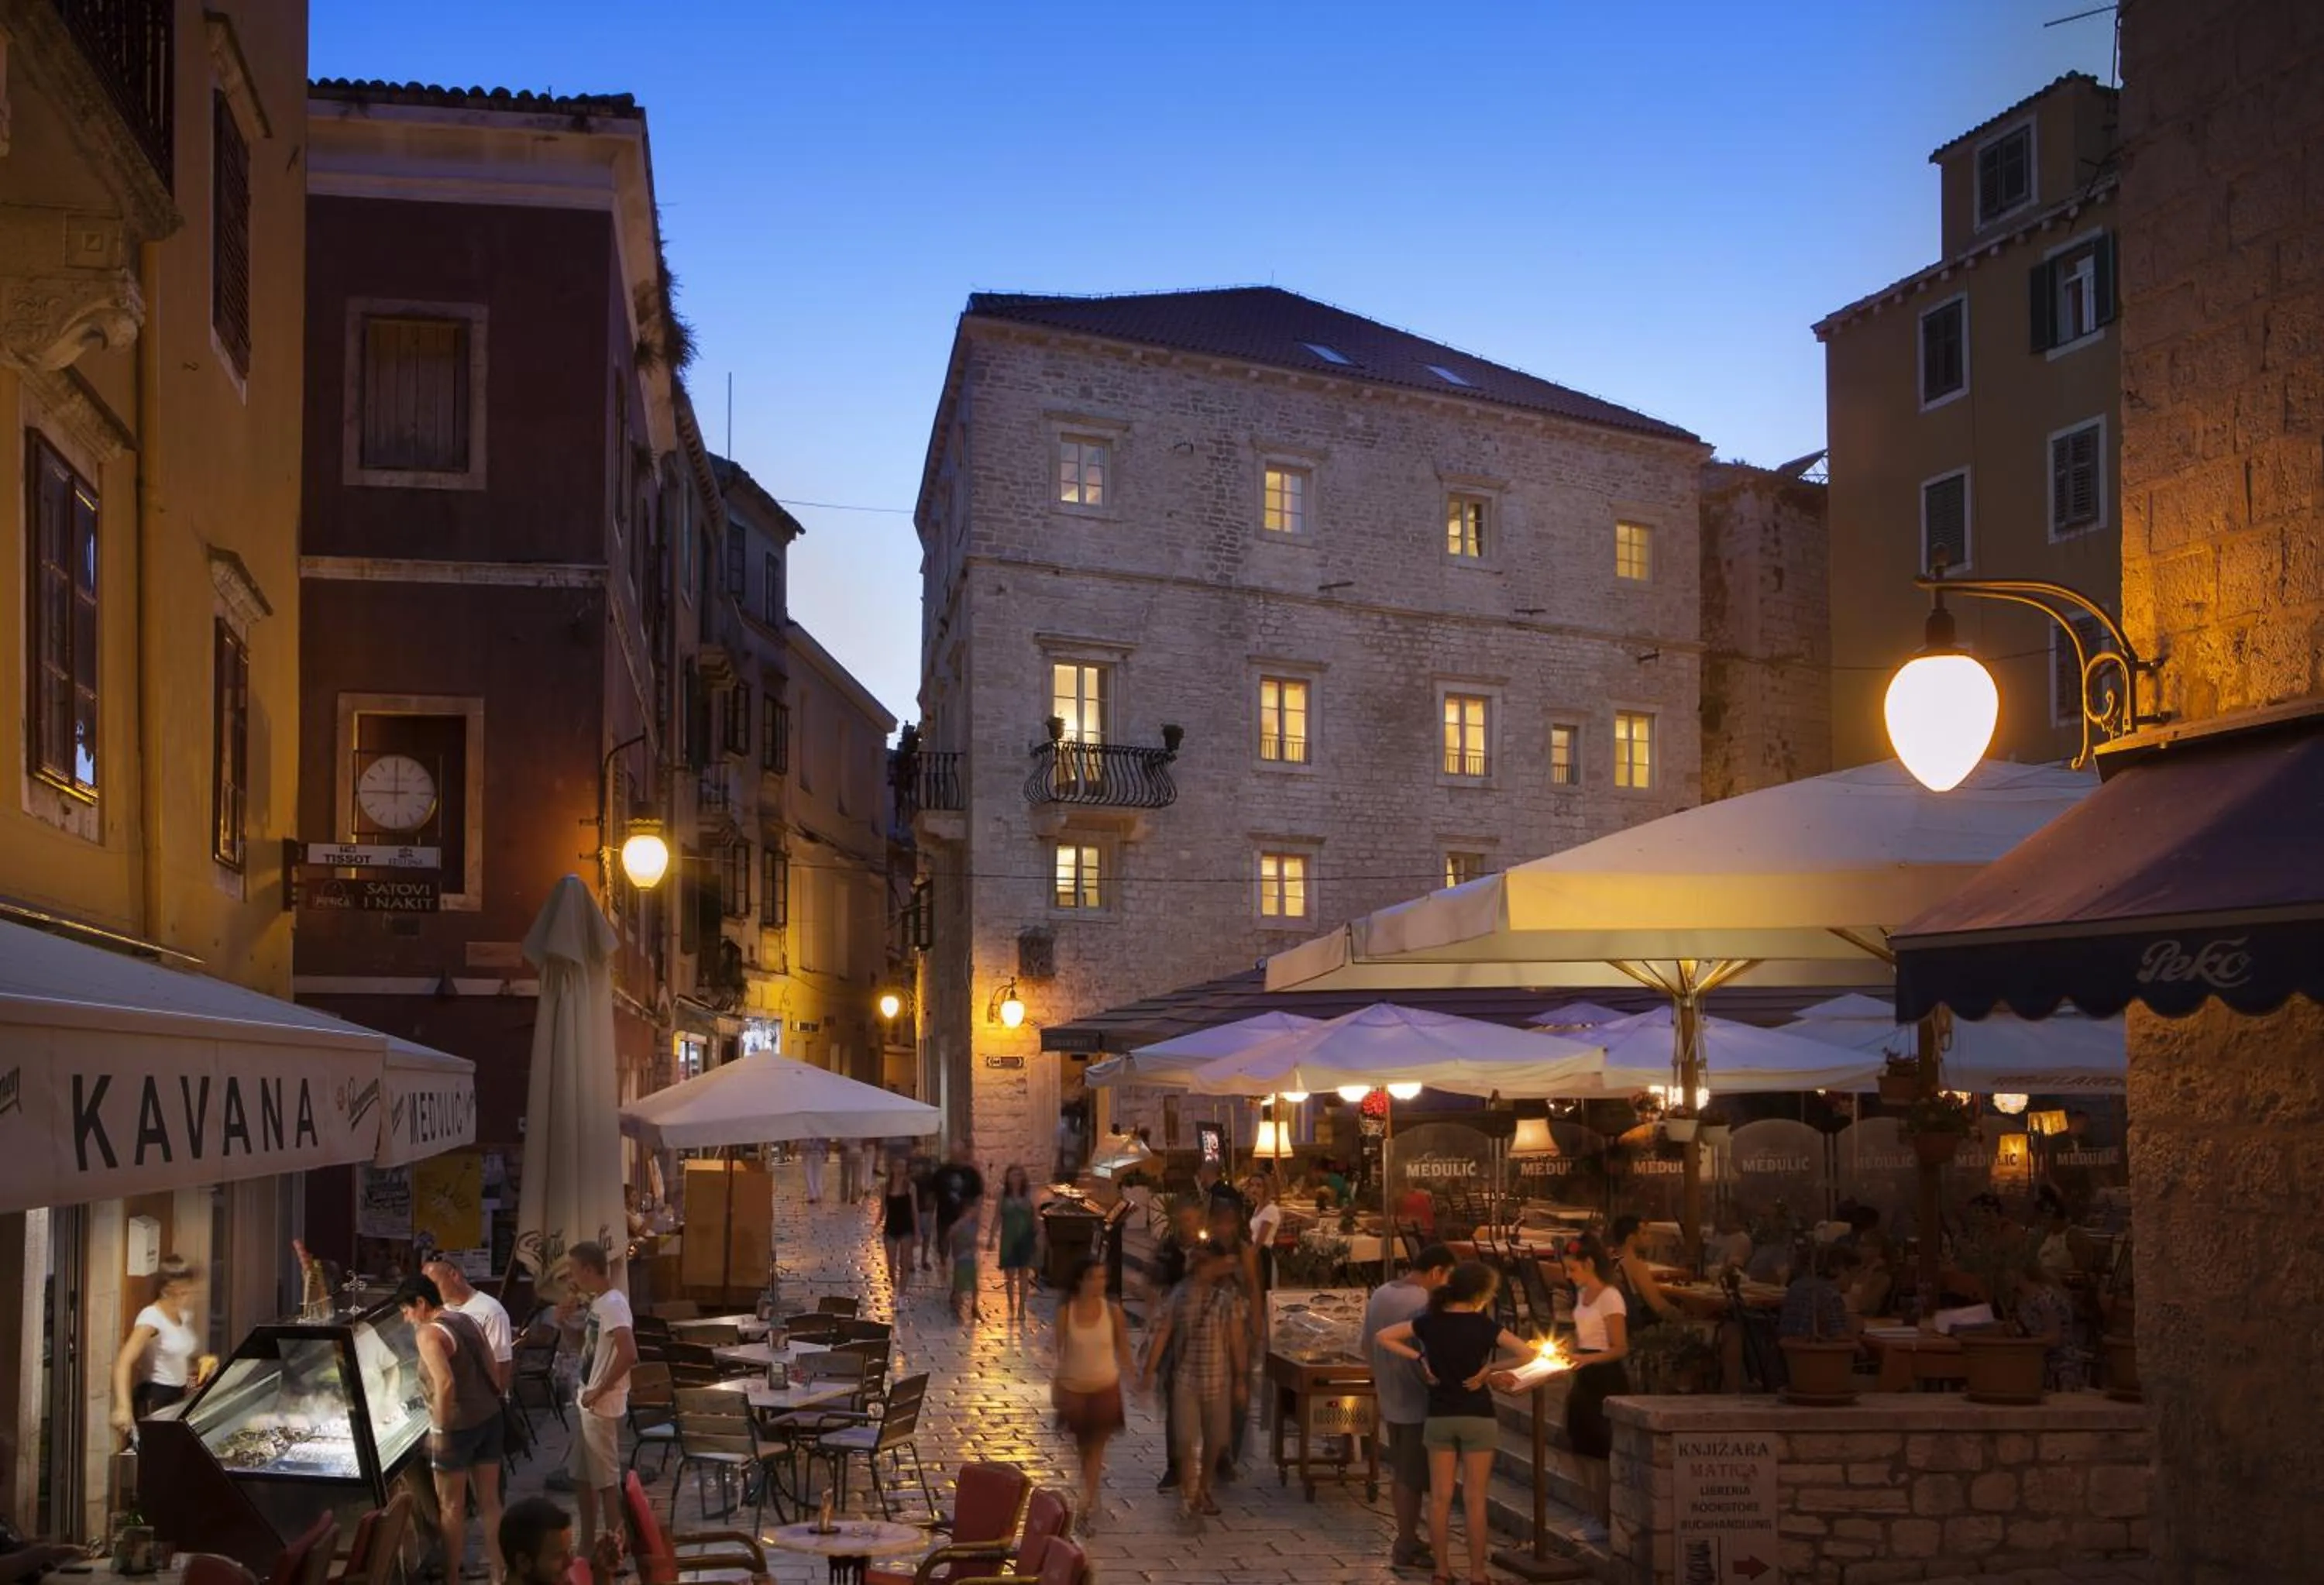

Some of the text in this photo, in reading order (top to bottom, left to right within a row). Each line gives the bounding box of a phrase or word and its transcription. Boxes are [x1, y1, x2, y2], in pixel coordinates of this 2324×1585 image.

[324, 854, 372, 864] TISSOT
[366, 882, 431, 896] SATOVI
[363, 896, 369, 909] I
[375, 897, 434, 909] NAKIT
[71, 1074, 319, 1172] KAVANA
[1520, 1161, 1573, 1176] MEDU
